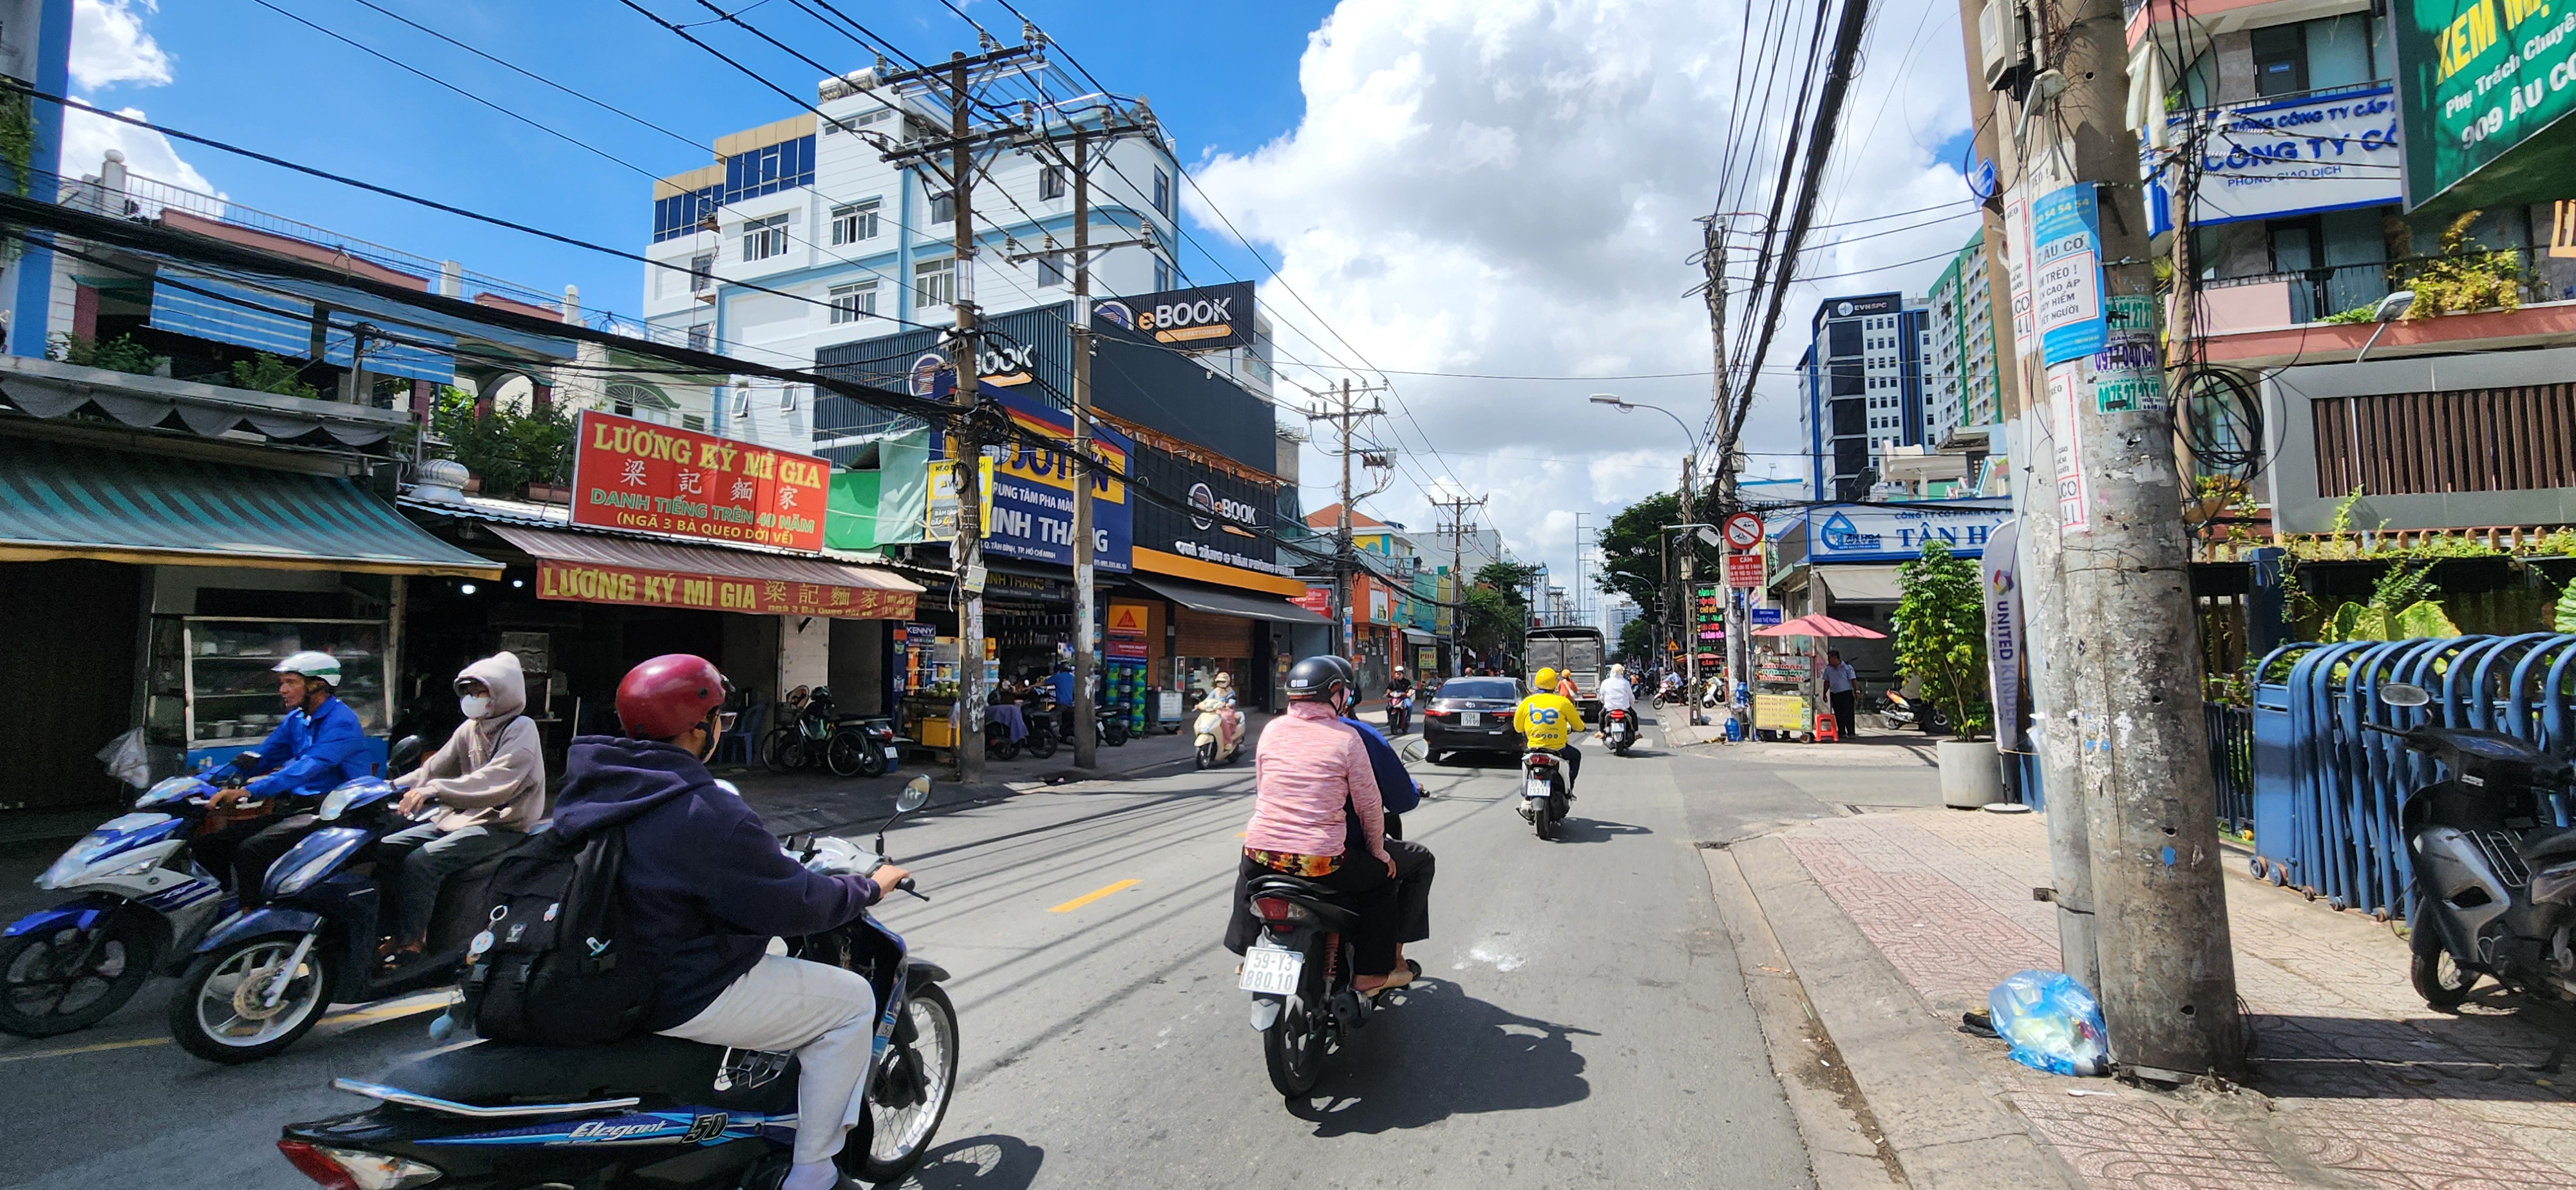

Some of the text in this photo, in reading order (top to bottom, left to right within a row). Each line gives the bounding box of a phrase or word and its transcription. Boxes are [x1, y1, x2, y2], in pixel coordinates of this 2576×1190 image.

[2434, 0, 2497, 86] XEM
[2446, 90, 2473, 118] Phụ
[2476, 54, 2521, 95] Trách
[2523, 12, 2576, 61] Chuyê
[2278, 109, 2324, 128] CÔNG
[2327, 106, 2350, 120] TY
[2353, 98, 2389, 117] CẤP
[2461, 106, 2504, 150] 909
[2509, 77, 2543, 121] ÂU
[2204, 141, 2298, 172] CÔNG
[2307, 133, 2351, 160] TY
[2311, 165, 2342, 178] DỊCH
[2043, 234, 2084, 261] ÂU CƠ
[2045, 267, 2070, 284] TRÈO
[2046, 283, 2063, 296] CAO
[2066, 278, 2081, 290] ÁP
[1855, 302, 1887, 310] EVNSPC
[2052, 290, 2075, 307] HIỂM
[1139, 296, 1232, 330] eBOOK
[2051, 305, 2079, 321] NGƯỜI
[593, 422, 821, 489] LƯƠNG KÝ MÌ GIA
[1012, 435, 1109, 492] JOTN
[992, 482, 1018, 499] RUNG
[1019, 487, 1039, 504] TÂM
[1039, 496, 1056, 509] PHA
[591, 487, 815, 534] DANH TIẾNG TRÊN 40 NĂM
[1214, 498, 1256, 525] eBOOK
[616, 511, 794, 545] (NGÃ 3 BÀ QUẸO DỜI VỀ)
[990, 507, 1108, 552] INH THG
[1896, 522, 1958, 547] TÂN
[542, 566, 756, 609] LƯƠNG KÝ MÌ GIA
[987, 573, 1006, 586] INH
[1996, 601, 2013, 661] UNITED
[1529, 703, 1559, 725] be
[1253, 952, 1293, 972] 59-Y3
[1245, 970, 1293, 991] 880.10
[568, 1113, 728, 1144] Elegant 50
